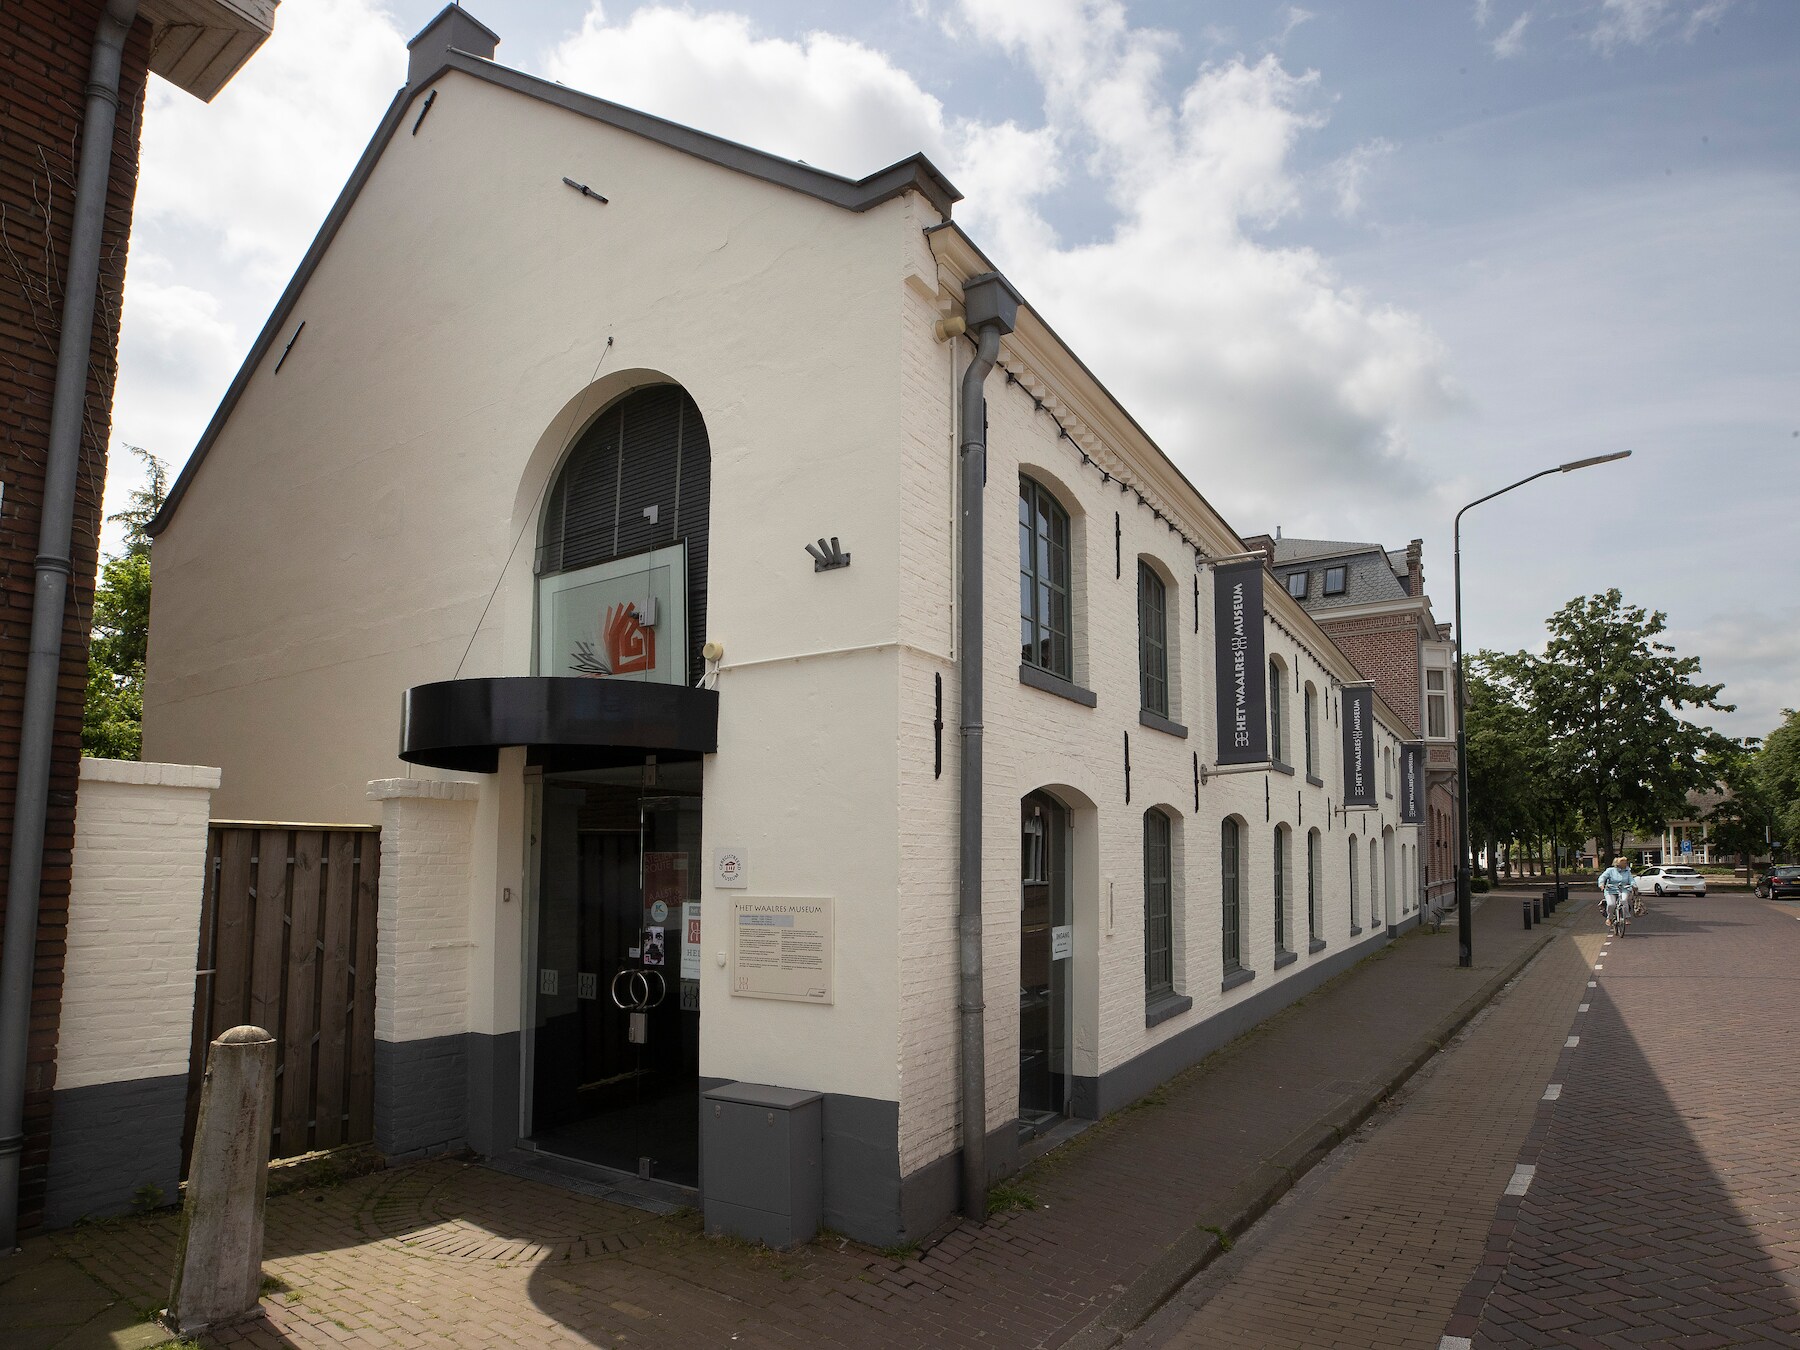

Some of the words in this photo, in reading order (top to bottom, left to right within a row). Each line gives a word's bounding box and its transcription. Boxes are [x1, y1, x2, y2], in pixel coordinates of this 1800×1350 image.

[1233, 583, 1244, 636] MUSEUM
[1234, 651, 1245, 706] WAALRES
[1236, 708, 1246, 731] HET
[1354, 739, 1362, 771] WAALRES
[1355, 773, 1363, 786] HET
[739, 904, 754, 912] HET
[754, 905, 787, 913] WAALRES
[788, 905, 822, 913] MUSEUM
